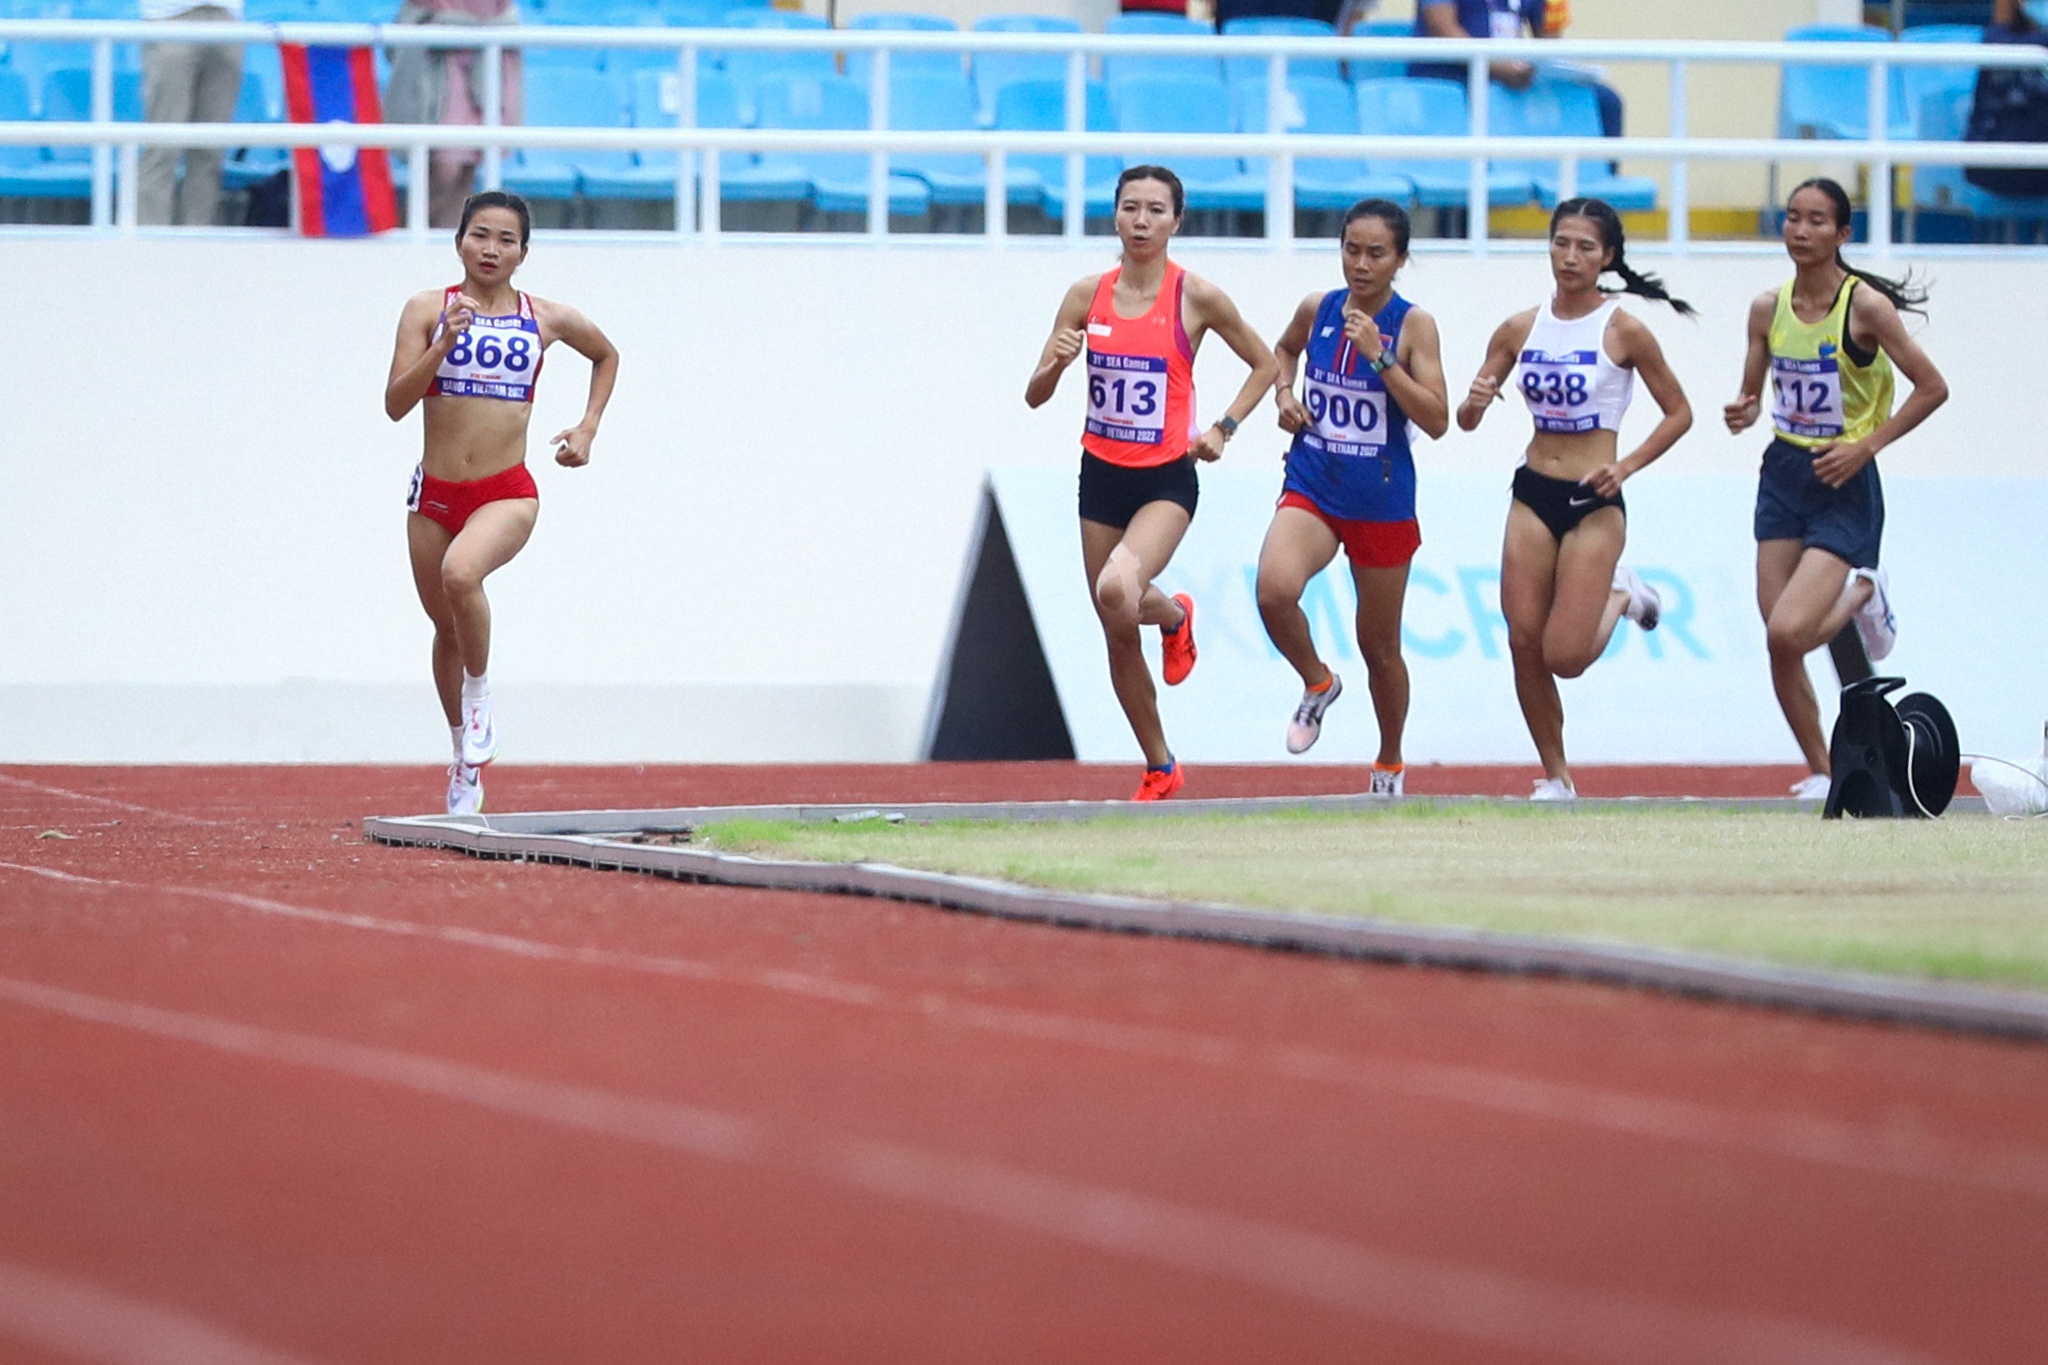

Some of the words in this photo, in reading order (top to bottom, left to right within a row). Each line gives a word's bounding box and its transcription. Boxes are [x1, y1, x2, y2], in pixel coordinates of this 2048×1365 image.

[446, 329, 530, 372] 868
[1106, 355, 1122, 368] SEA
[1089, 374, 1157, 416] 613
[1523, 371, 1588, 406] 838
[1309, 388, 1378, 432] 900
